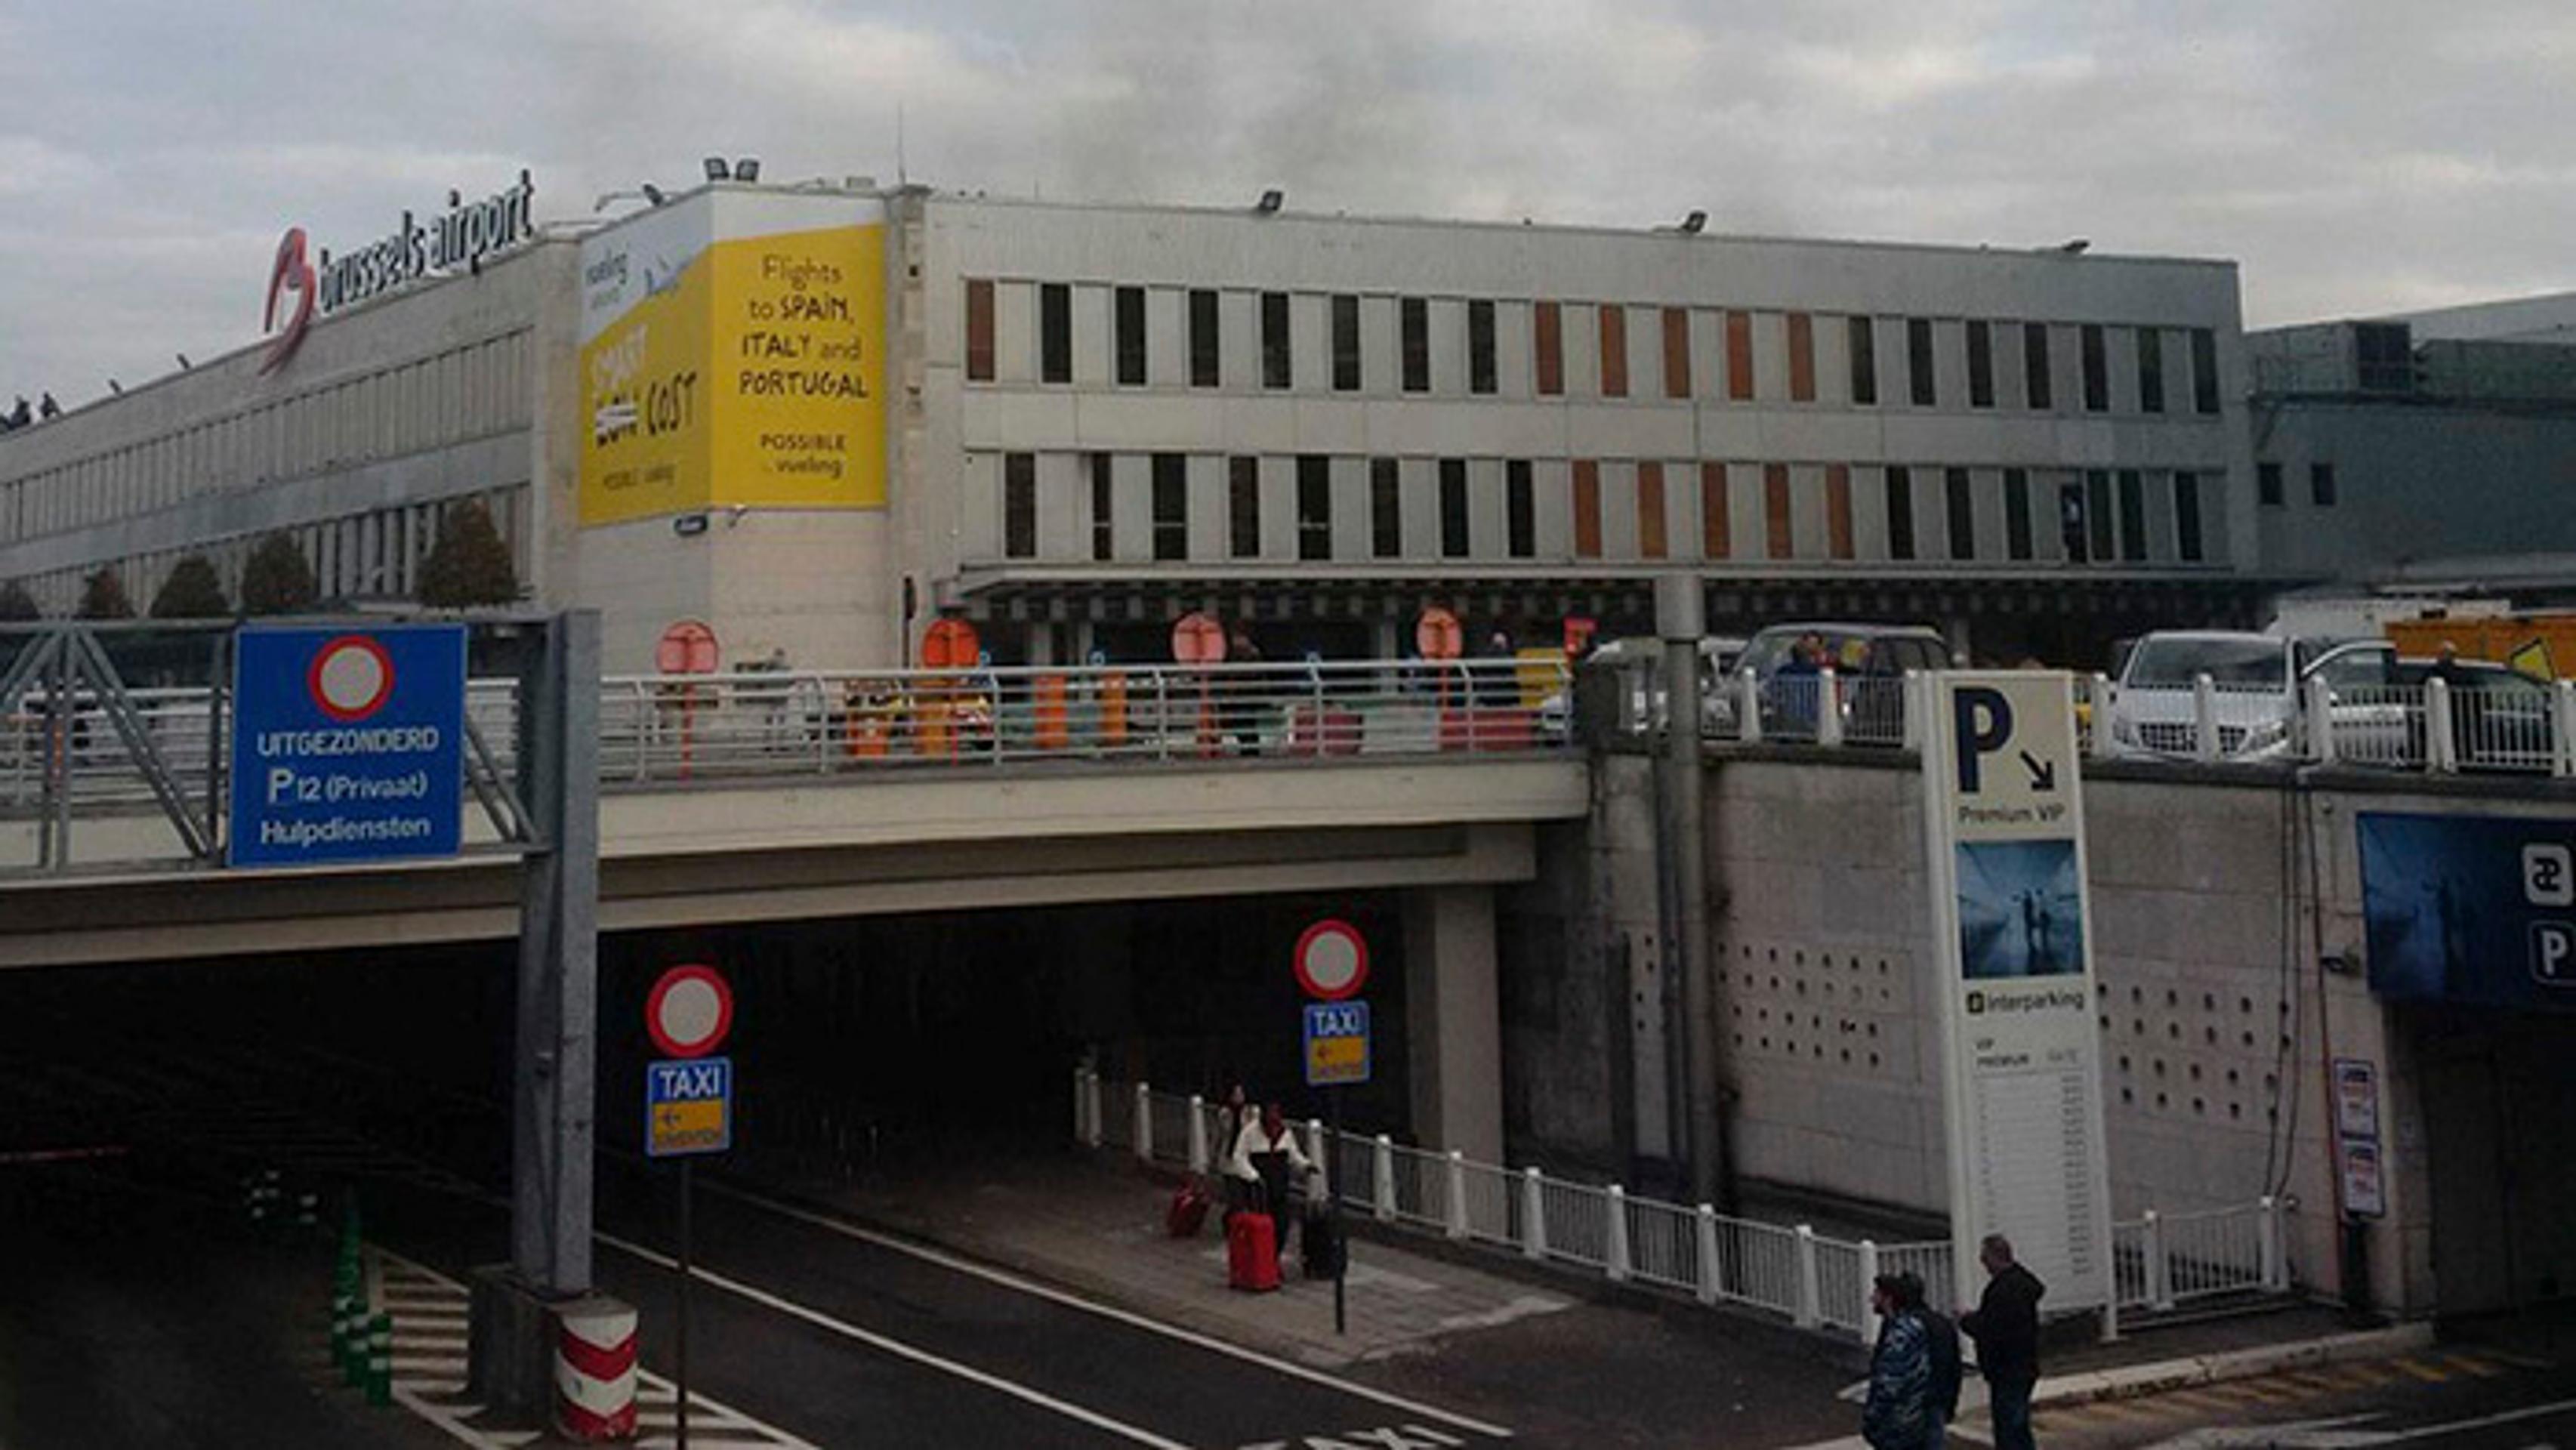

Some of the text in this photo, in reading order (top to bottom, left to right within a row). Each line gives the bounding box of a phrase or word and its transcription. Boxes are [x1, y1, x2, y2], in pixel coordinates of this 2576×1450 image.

[319, 168, 535, 313] brussels airport
[762, 253, 842, 291] Flights
[749, 299, 774, 320] to
[742, 330, 862, 360] ITALY and
[739, 369, 870, 399] PORTUGAL
[646, 371, 698, 437] COST
[760, 433, 846, 451] POSSIBLE
[257, 726, 440, 757] UITGEZONDERD
[1953, 686, 2014, 793] P
[325, 770, 429, 804] (Privaat)
[1957, 802, 2066, 823] Premium VIP
[260, 816, 432, 849] Hulpdiensten
[2541, 930, 2568, 976] P
[1313, 1007, 1360, 1037] TAXI
[659, 1065, 720, 1099] TAXI
